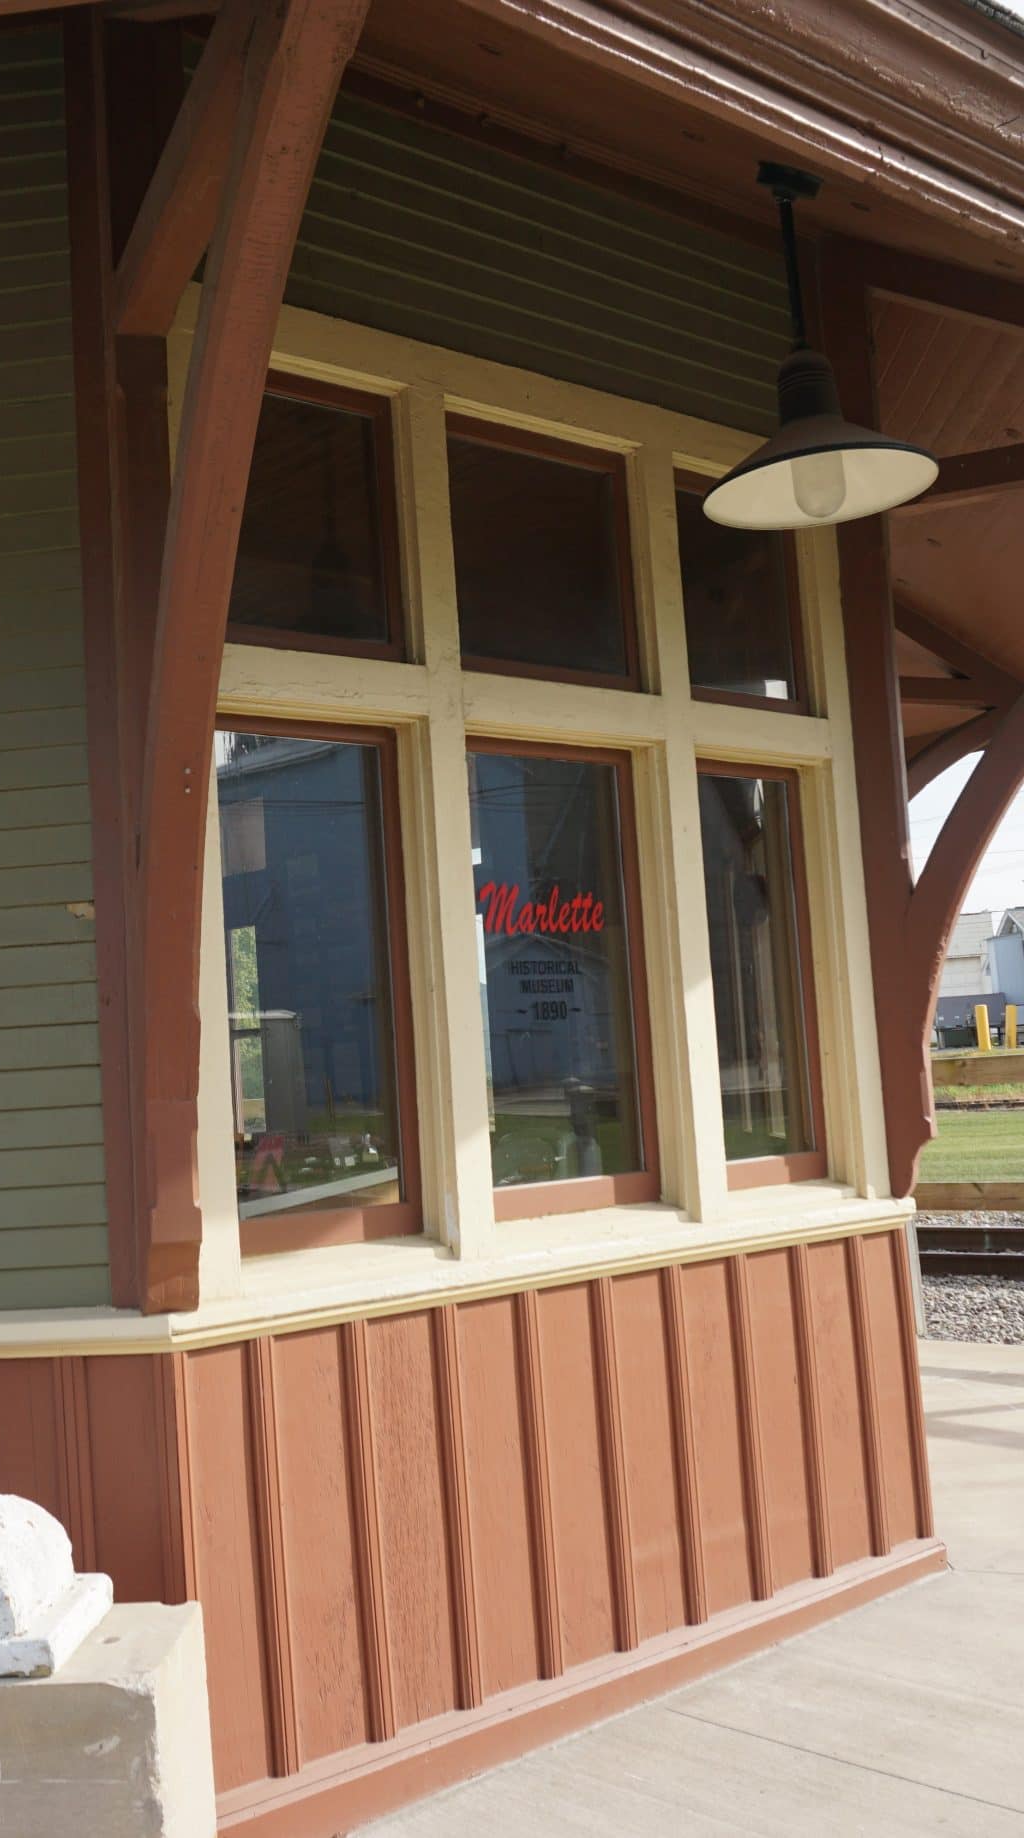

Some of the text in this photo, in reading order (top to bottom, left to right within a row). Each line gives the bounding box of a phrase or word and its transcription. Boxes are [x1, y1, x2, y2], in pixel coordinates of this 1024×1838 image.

[479, 880, 604, 937] Marlette
[510, 960, 581, 975] HISTORICAL
[520, 978, 574, 994] MUSEUM
